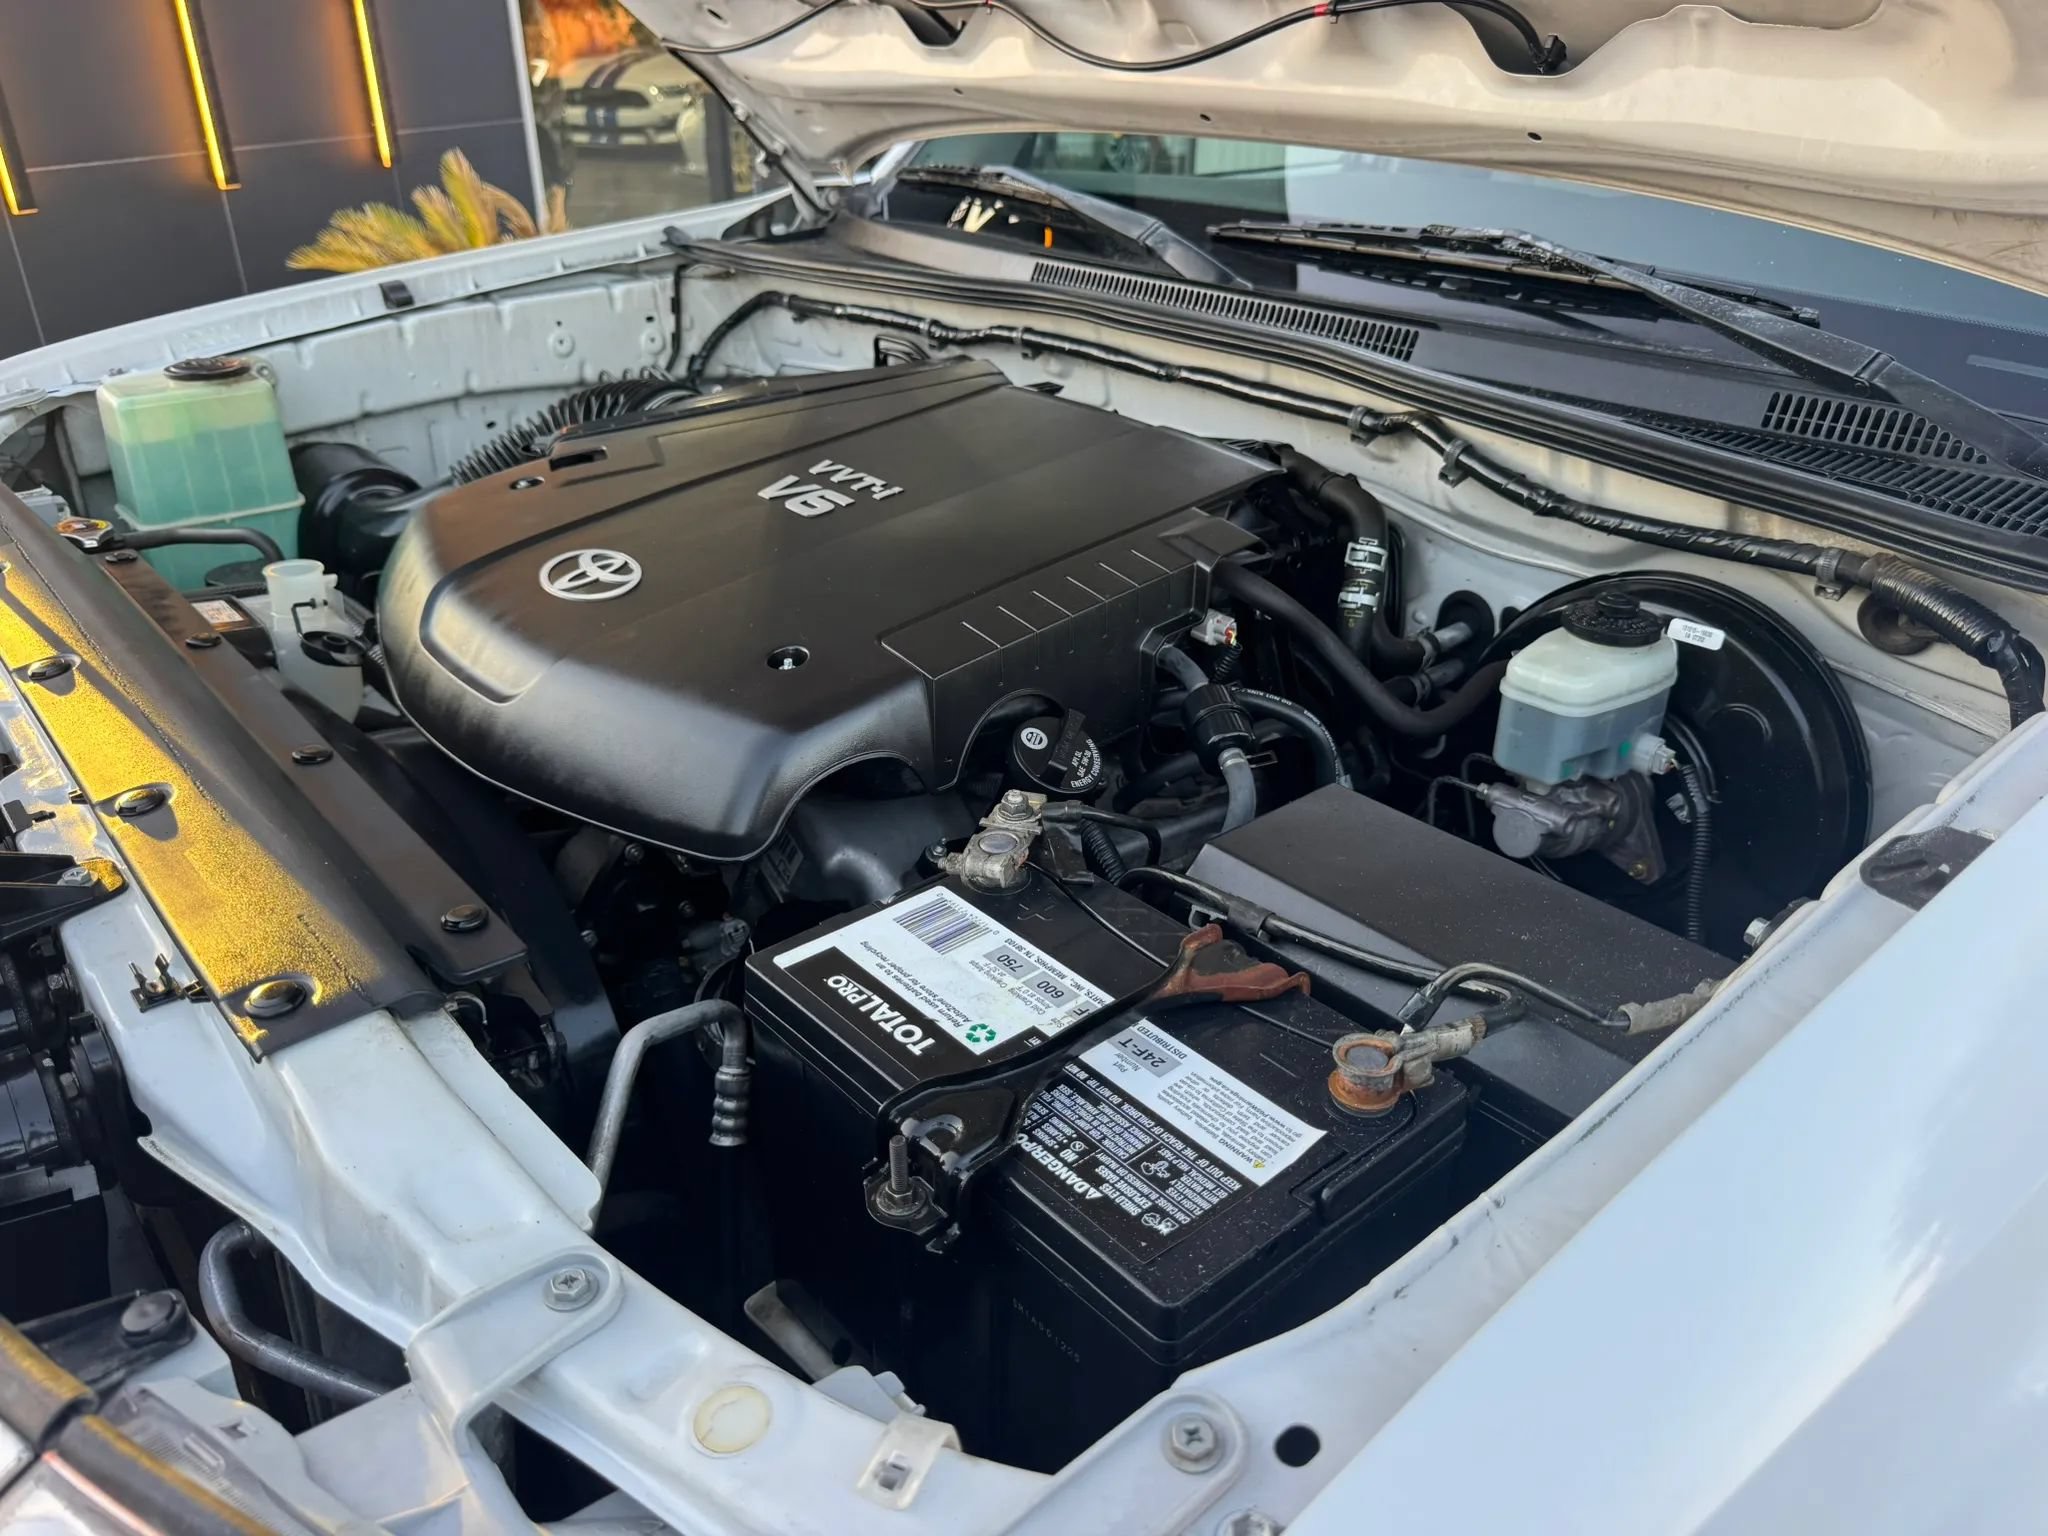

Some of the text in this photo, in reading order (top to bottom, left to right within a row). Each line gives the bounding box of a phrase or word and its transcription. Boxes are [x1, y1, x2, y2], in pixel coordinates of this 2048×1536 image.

[757, 474, 855, 517] V6
[1077, 765, 1086, 777] SAE
[1070, 774, 1094, 788] ENERGY
[1022, 950, 1036, 958] TN
[885, 960, 913, 979] proper
[994, 953, 1025, 972] 750
[889, 974, 922, 997] batteries
[907, 976, 922, 986] for
[916, 984, 939, 998] store
[1005, 987, 1033, 1006] Cranking
[1034, 979, 1066, 999] 600
[918, 995, 940, 1010] used
[935, 1008, 963, 1027] Return
[1135, 1025, 1188, 1059] DISTRIBUTED
[1117, 1035, 1166, 1068] 24F-T
[1111, 1061, 1129, 1072] Part
[1112, 1051, 1141, 1071] Number
[1094, 1084, 1113, 1097] NOT
[1107, 1093, 1123, 1104] DO
[1095, 1112, 1111, 1123] NOT
[1031, 1127, 1057, 1146] SPARKS
[1040, 1122, 1066, 1141] FLAMES
[1087, 1128, 1104, 1139] FOR
[1150, 1124, 1165, 1134] OF
[1159, 1131, 1186, 1150] REACH
[1058, 1147, 1079, 1162] NO
[1180, 1146, 1199, 1159] THE
[1010, 1131, 1091, 1194] DANGER/PO
[1171, 1157, 1191, 1171] HELP
[1195, 1156, 1210, 1167] OF
[1114, 1166, 1128, 1176] OR
[1204, 1163, 1224, 1178] OUT
[1093, 1164, 1153, 1208] EXPLOSIVE GASES
[1186, 1168, 1216, 1190] MEDICAL
[1219, 1174, 1242, 1190] KEEP
[1097, 1182, 1142, 1216] SHIELD EYES
[1168, 1178, 1212, 1209] IMMEDIATELY
[1200, 1189, 1219, 1203] WITH
[1211, 1186, 1228, 1198] GET
[1154, 1196, 1178, 1214] CAUSE
[1164, 1186, 1203, 1215] FLUSH EYES
[1173, 1210, 1191, 1224] CAN
